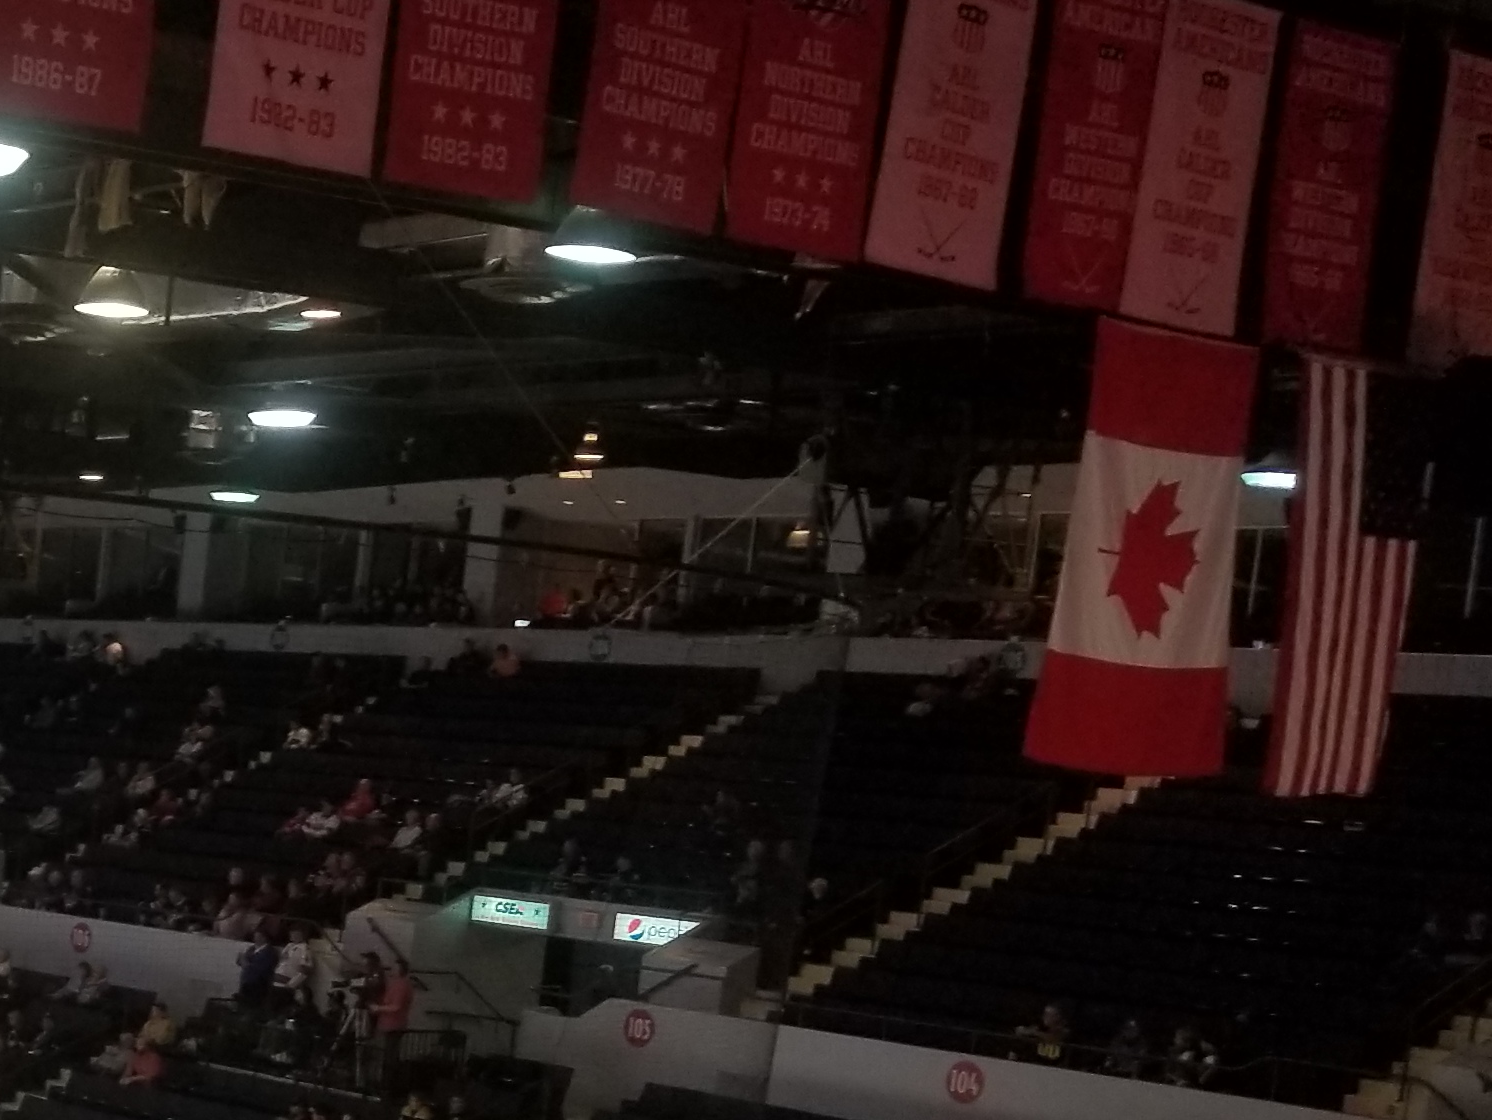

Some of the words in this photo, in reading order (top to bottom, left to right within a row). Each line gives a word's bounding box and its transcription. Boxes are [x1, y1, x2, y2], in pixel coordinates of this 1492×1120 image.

[238, 3, 366, 56] CHAMPIONS
[427, 22, 524, 65] DIVISION
[613, 23, 722, 73] SOUTHERN
[797, 37, 835, 68] AHL
[11, 54, 103, 96] 1986-87
[408, 53, 534, 100] CHAMPIONS
[618, 57, 708, 102] DIVISION
[764, 61, 864, 105] NORTHERN
[249, 95, 336, 138] 1982-83
[601, 85, 717, 137] CHAMPIONS
[769, 94, 852, 134] DIVISION
[421, 133, 508, 173] 1982-83
[750, 122, 859, 167] CHAMPIONS
[614, 162, 687, 201] 1977-78
[628, 1016, 652, 1040] 105
[949, 1069, 979, 1095] 104
